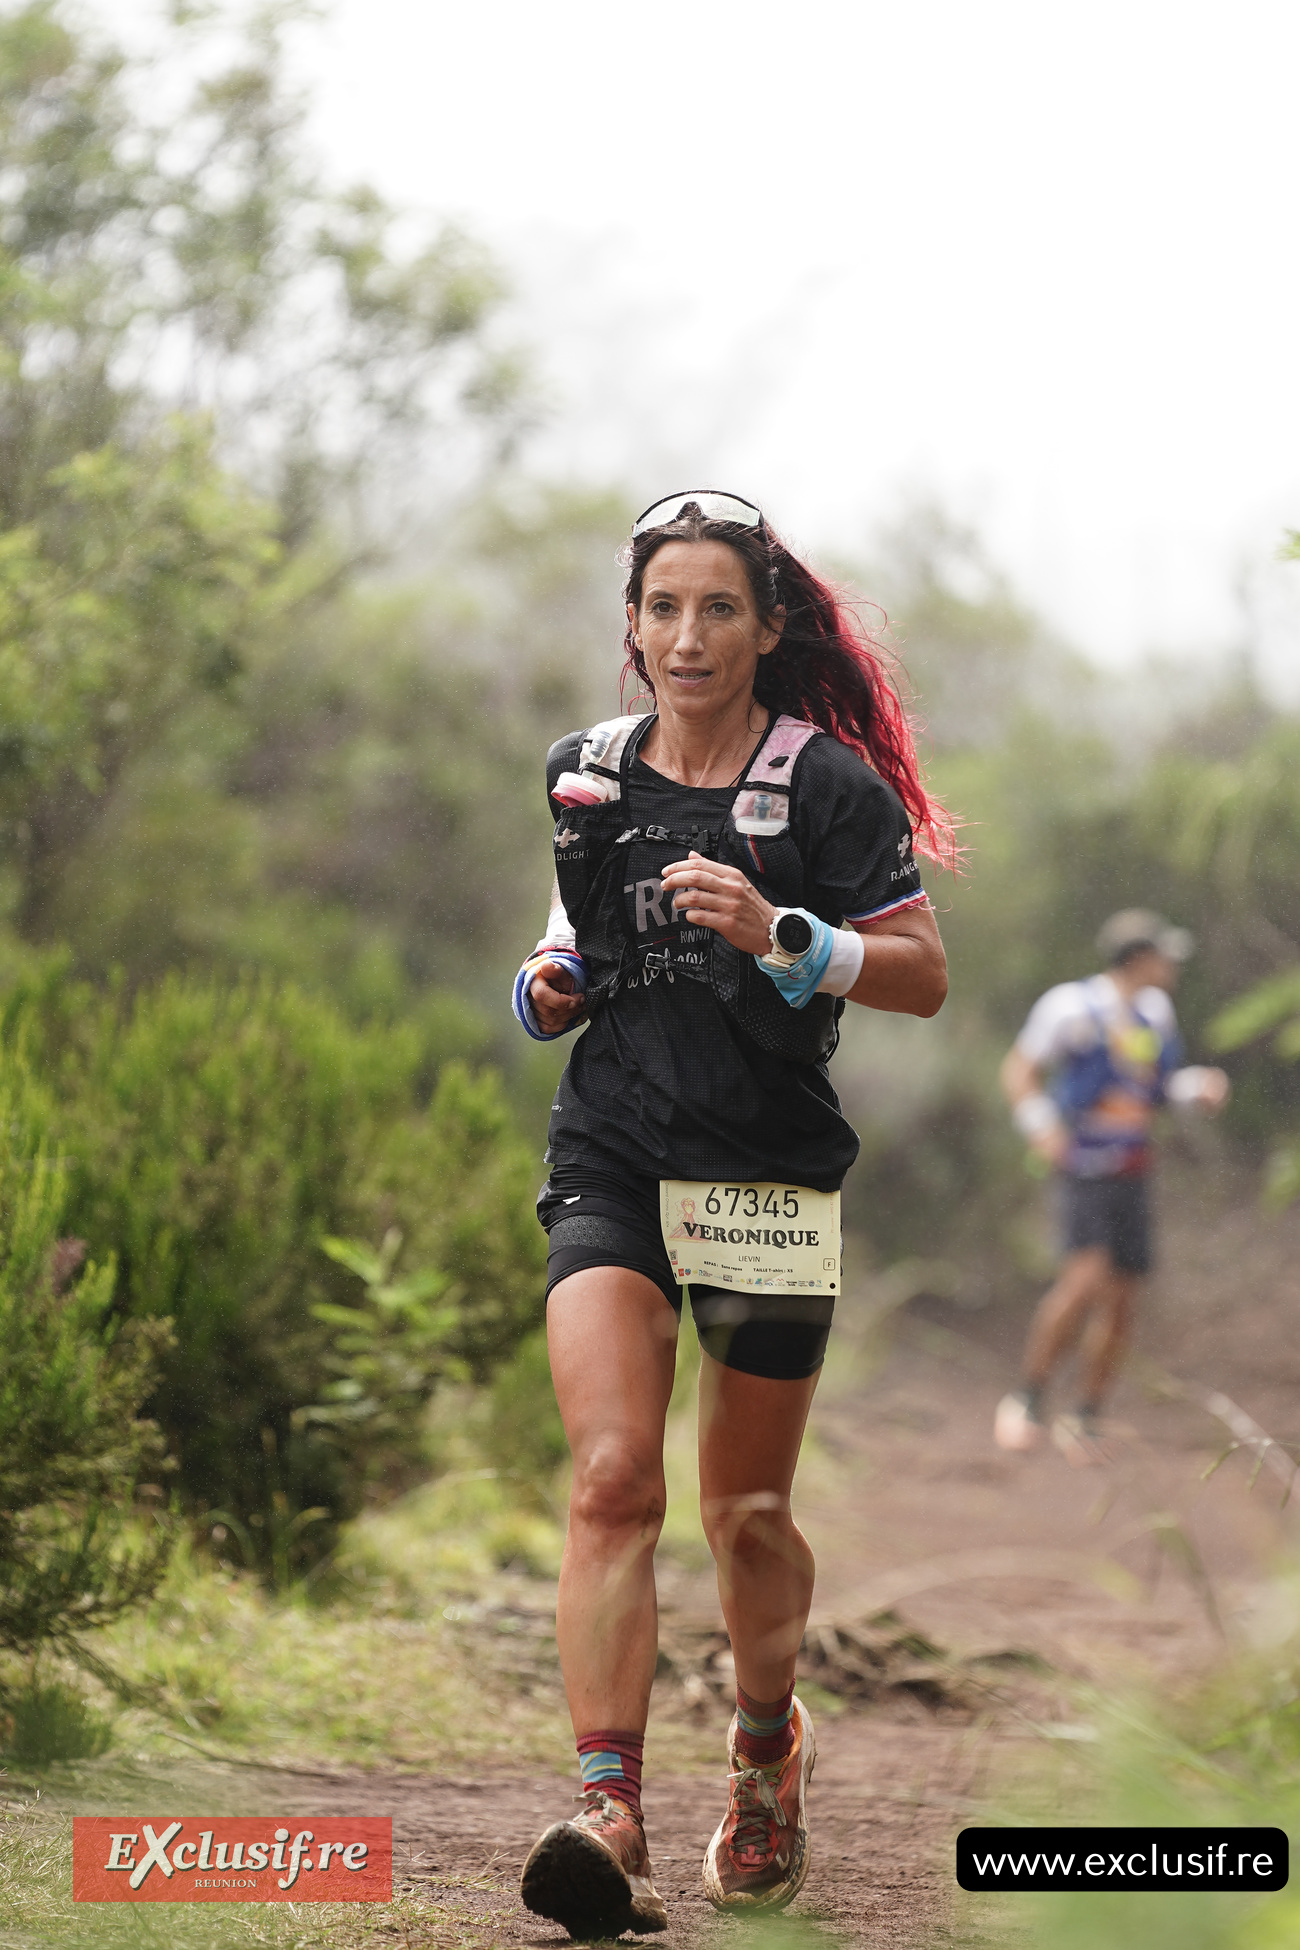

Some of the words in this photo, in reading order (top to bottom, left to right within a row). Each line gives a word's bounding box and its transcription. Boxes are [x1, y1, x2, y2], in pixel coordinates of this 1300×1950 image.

[555, 849, 590, 861] DLIGHT
[705, 1187, 799, 1218] 67345
[682, 1221, 820, 1250] VERONIQUE
[738, 1255, 761, 1263] LIEVIN
